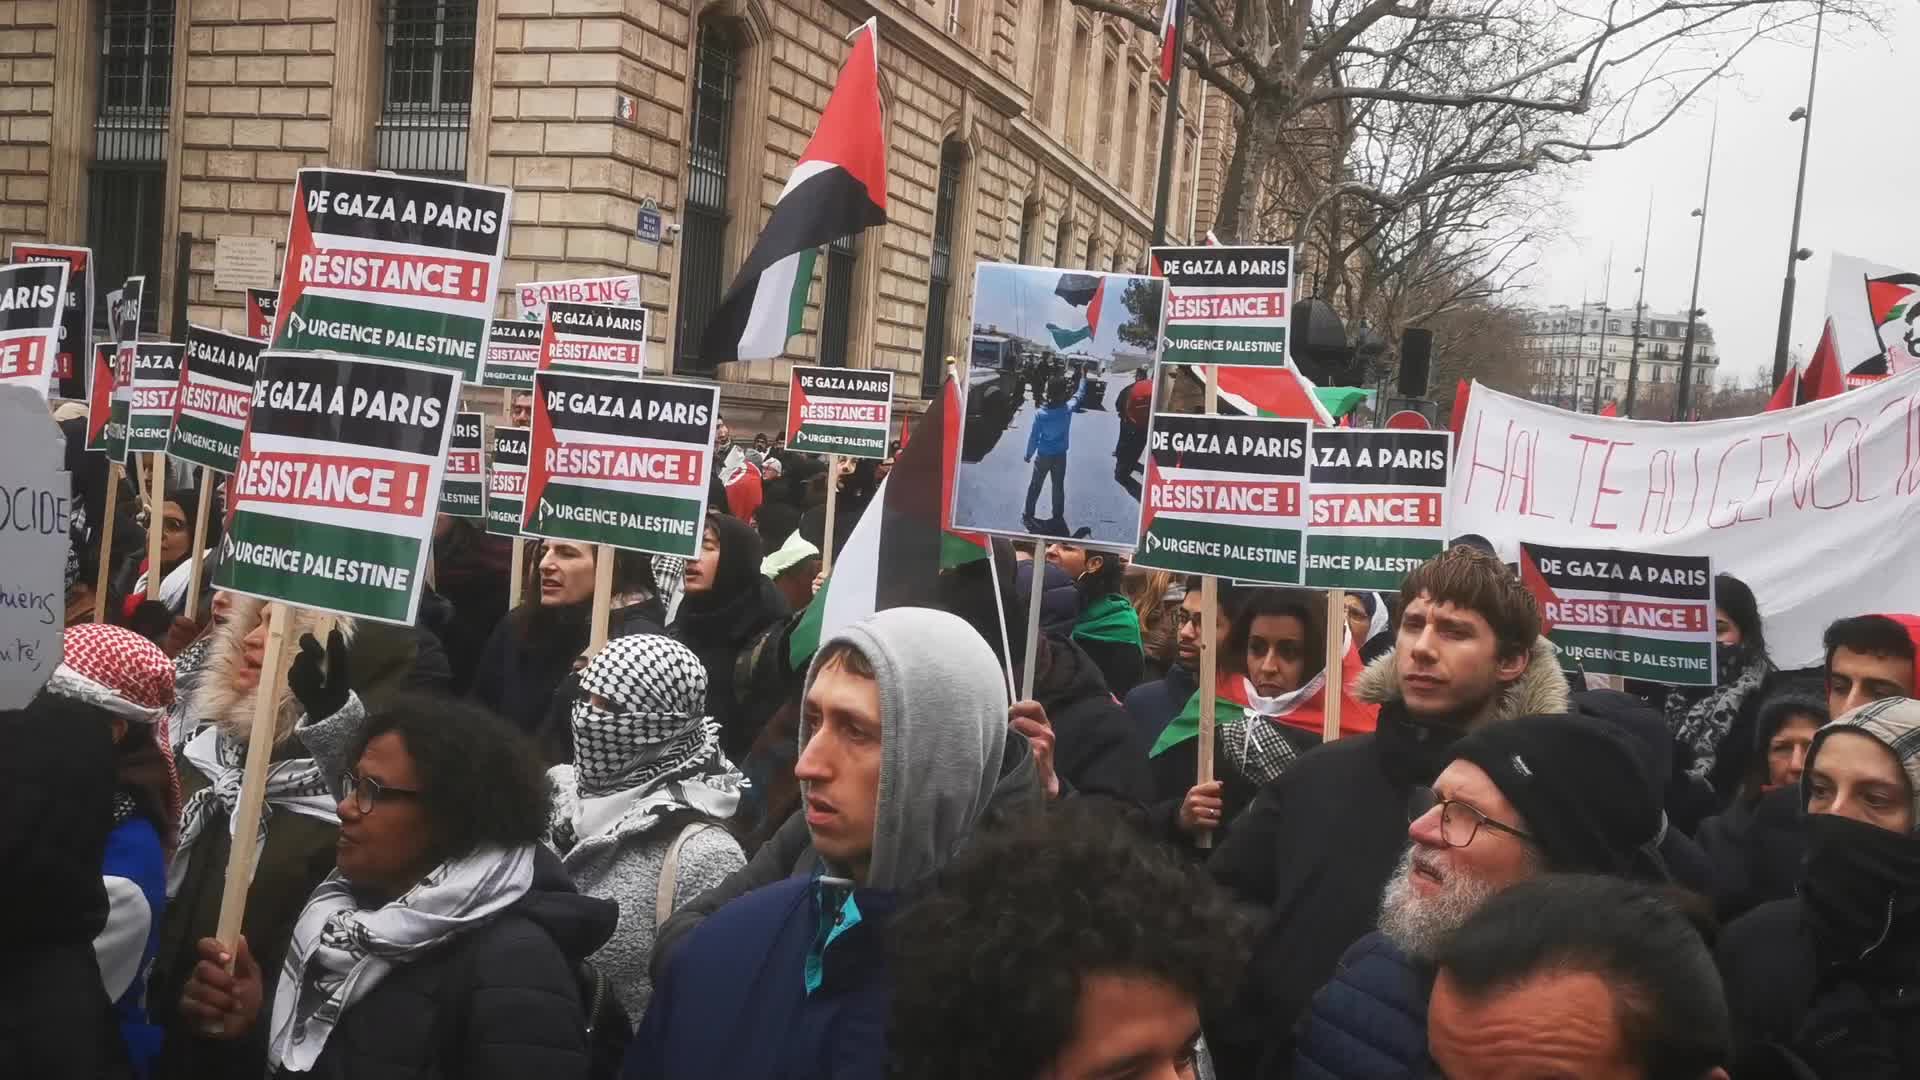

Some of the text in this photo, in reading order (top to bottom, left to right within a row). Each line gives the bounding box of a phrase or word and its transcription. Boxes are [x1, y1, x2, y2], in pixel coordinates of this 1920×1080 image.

[308, 190, 498, 235] DE GAZA A PARIS
[300, 248, 462, 296] RÉSISTANCE
[470, 267, 481, 297] !
[1164, 260, 1286, 275] DE GAZA A PARIS
[1167, 293, 1280, 318] RÉSISTANCE !
[528, 330, 540, 338] PA
[552, 312, 642, 332] DE GAZA A PARIS
[308, 319, 477, 360] URGENCE PALESTINE
[549, 338, 637, 362] RÉSISTANCE !
[1176, 339, 1283, 352] URGENCE PALESTINE
[198, 343, 226, 364] GAZA
[228, 351, 235, 368] A
[802, 376, 888, 393] DE GAZA A PARIS
[182, 382, 250, 418] RÉSISTANC
[252, 380, 442, 428] DE GAZA A PARIS
[548, 390, 708, 426] DE GAZA A PARIS
[800, 402, 884, 420] RÉSISTANCE !
[182, 432, 240, 458] URGENCE PALE
[499, 440, 527, 455] GAZA
[808, 434, 884, 448] URGENCE PALESTINE
[1152, 432, 1302, 459] DE GAZA A PARIS
[544, 442, 696, 482] RÉSISTANCE !
[1356, 448, 1373, 468] A
[1378, 448, 1444, 470] PARIS
[1464, 408, 1636, 529] HALTE
[1639, 448, 1700, 534] AU
[236, 451, 419, 510] RÉSISTANCE !
[1151, 479, 1294, 512] RÉSISTANCE !
[490, 511, 522, 523] URGENC
[556, 504, 695, 537] URGENCE PALESTINE
[1428, 498, 1436, 522] !
[1162, 538, 1297, 564] URGENCE PALESTINE
[235, 541, 410, 591] URGENCE PALESTINE
[1540, 558, 1706, 586] DE GAZA A PARIS
[1545, 599, 1702, 629] RÉSISTANCE !
[1566, 646, 1708, 670] URGENCE PALESTINE
